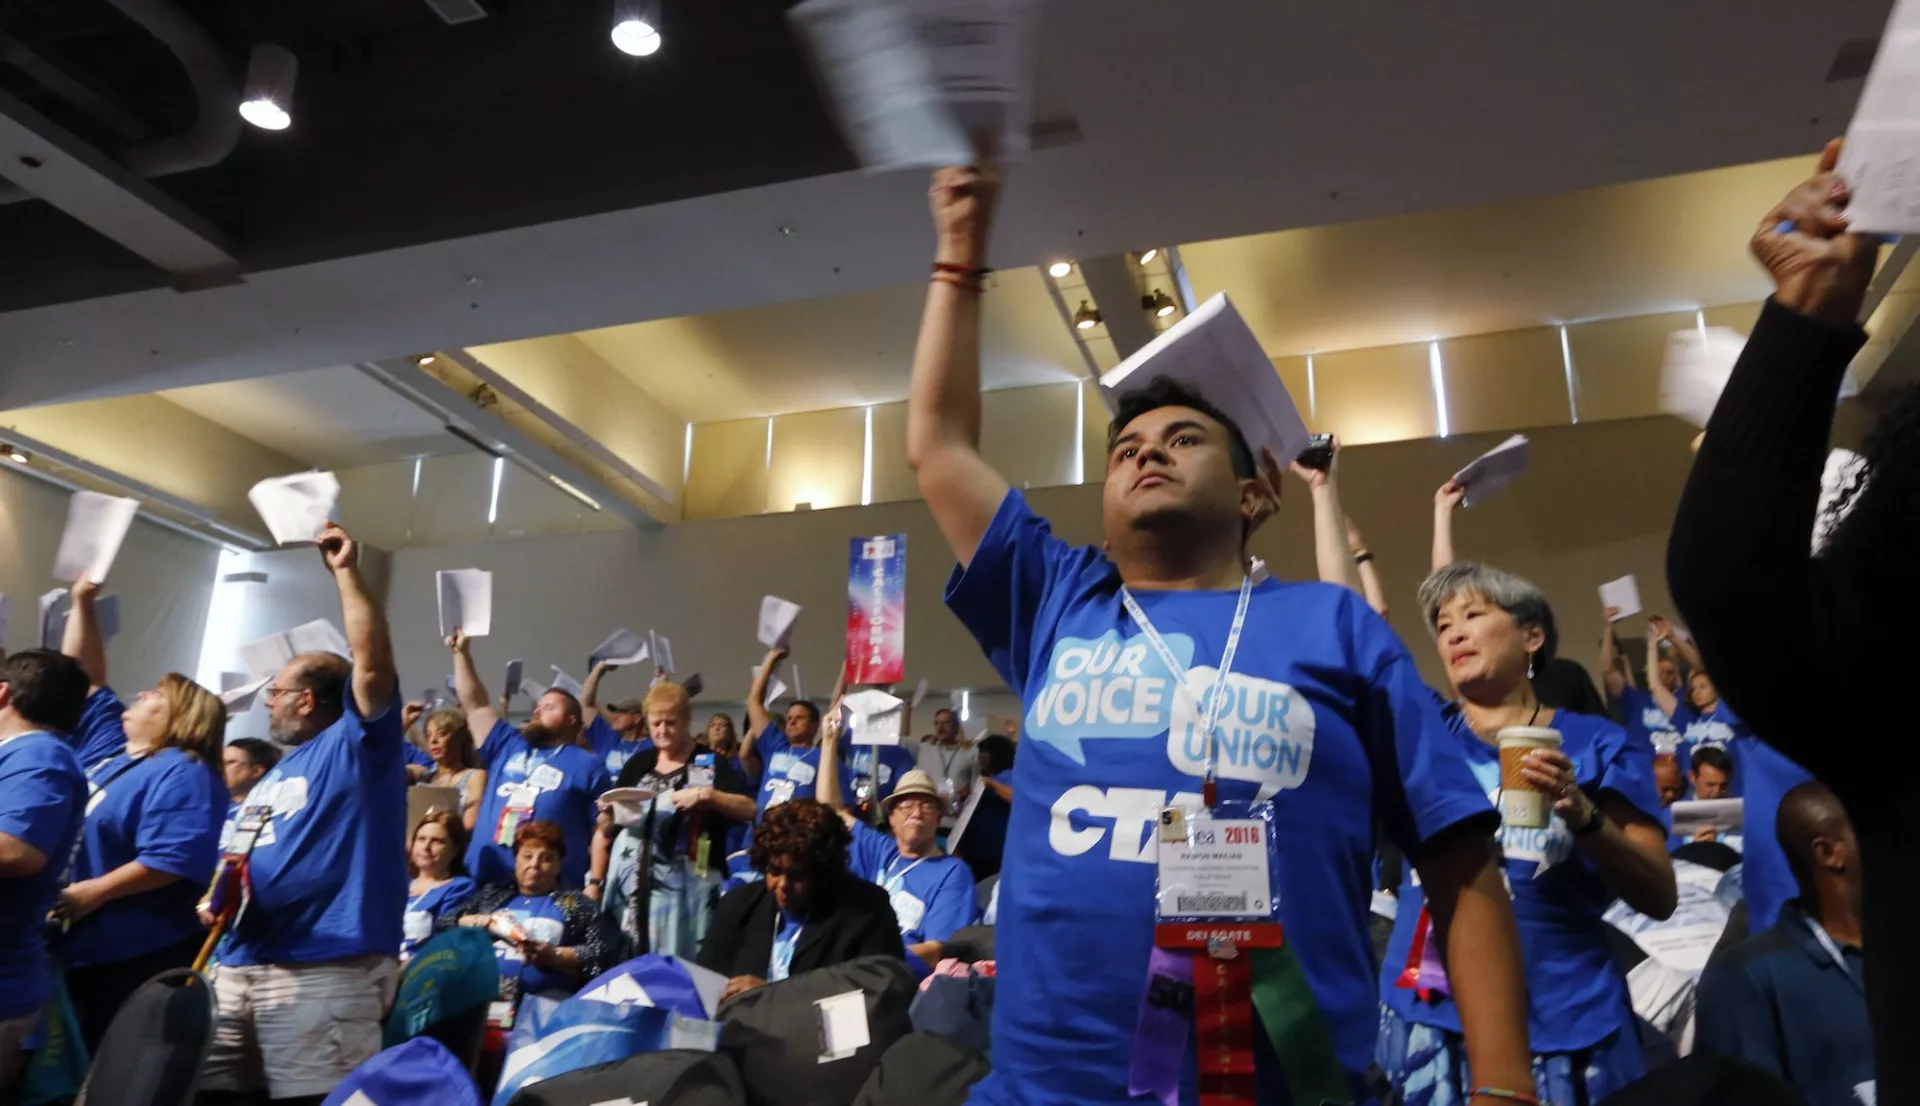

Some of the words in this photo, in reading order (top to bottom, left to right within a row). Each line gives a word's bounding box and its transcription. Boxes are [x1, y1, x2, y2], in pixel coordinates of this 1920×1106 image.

[1055, 640, 1147, 679] OUR
[1036, 676, 1168, 728] VOICE
[1203, 683, 1291, 733] OUR
[1182, 719, 1304, 777] UNION
[1224, 825, 1260, 845] 2016
